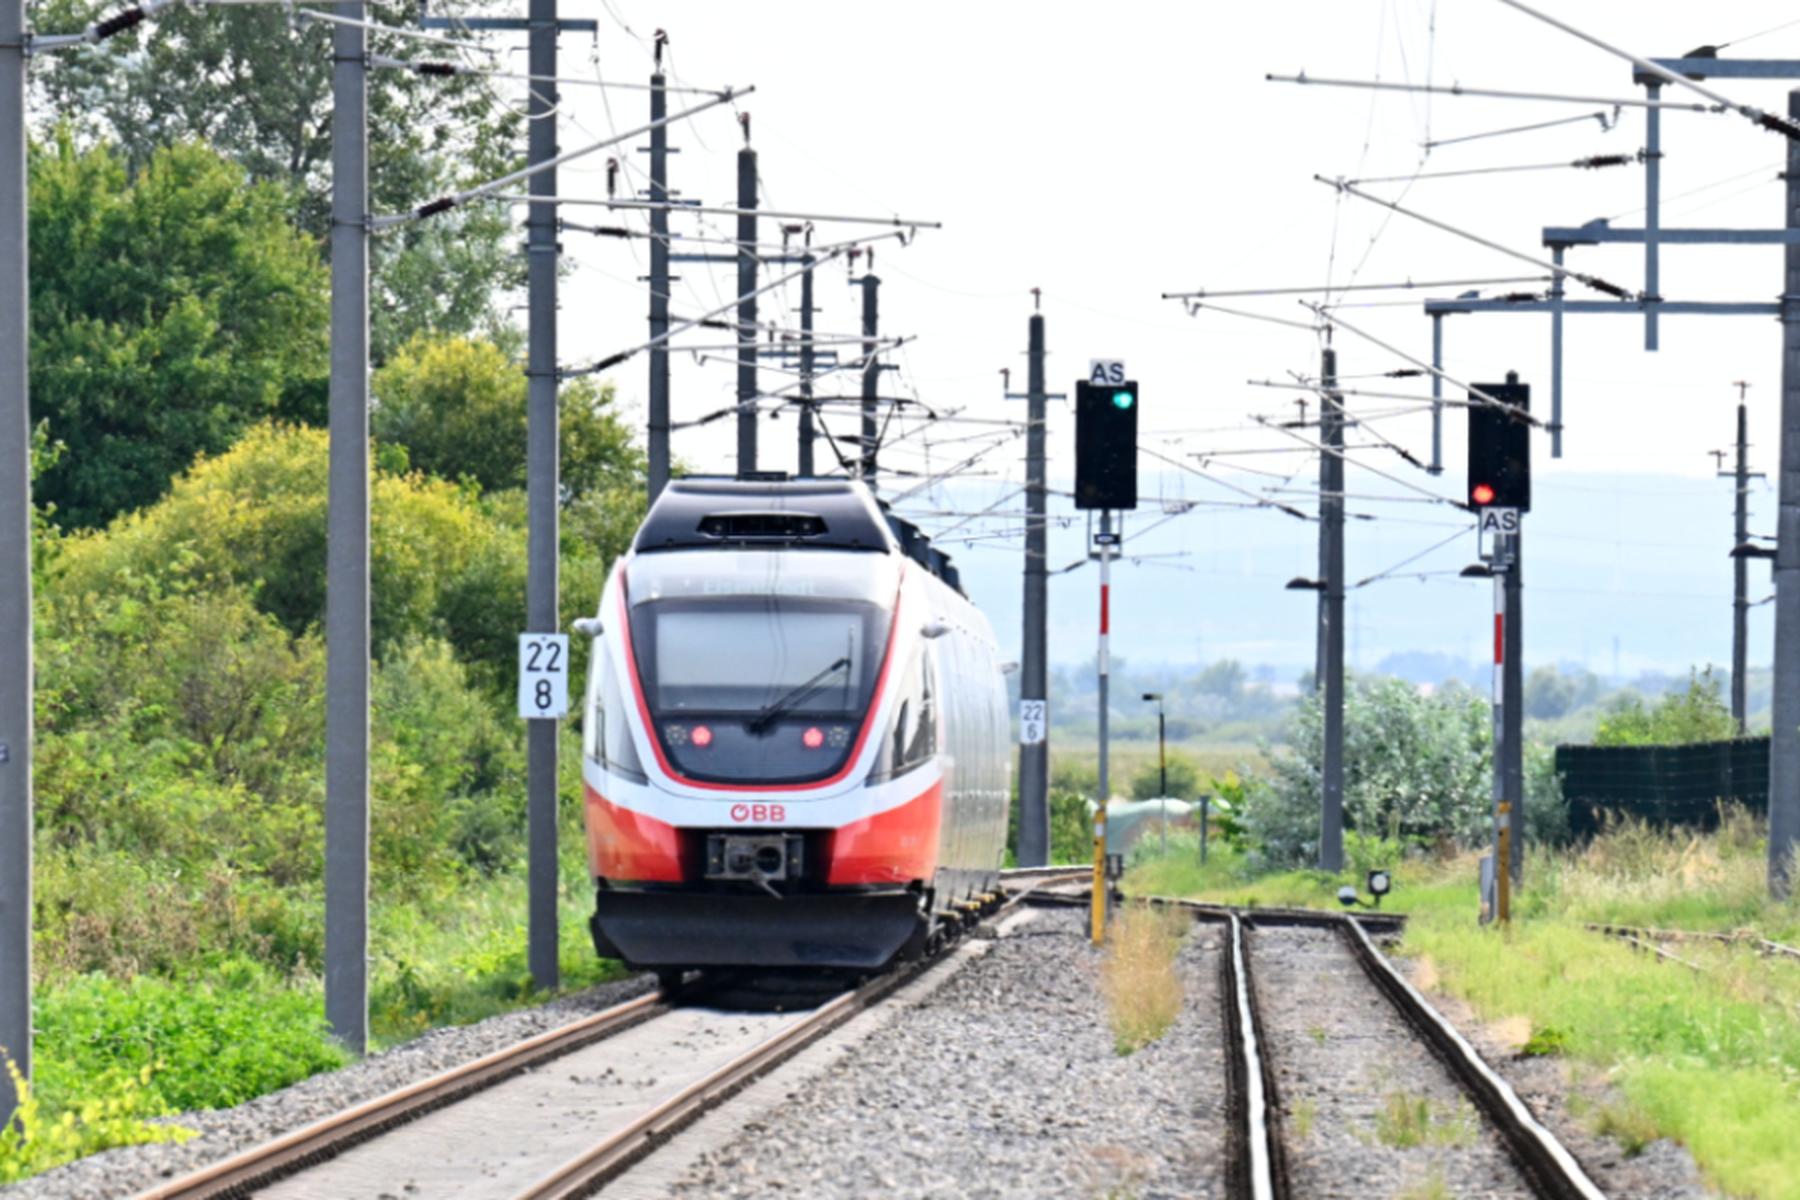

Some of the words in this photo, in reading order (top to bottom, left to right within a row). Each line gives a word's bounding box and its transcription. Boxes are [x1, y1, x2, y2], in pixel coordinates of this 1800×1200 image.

[1090, 362, 1124, 383] AS
[1483, 511, 1517, 531] AS
[526, 642, 561, 672] 22
[535, 679, 552, 710] 8
[1023, 704, 1042, 721] 22
[1027, 723, 1038, 740] 6
